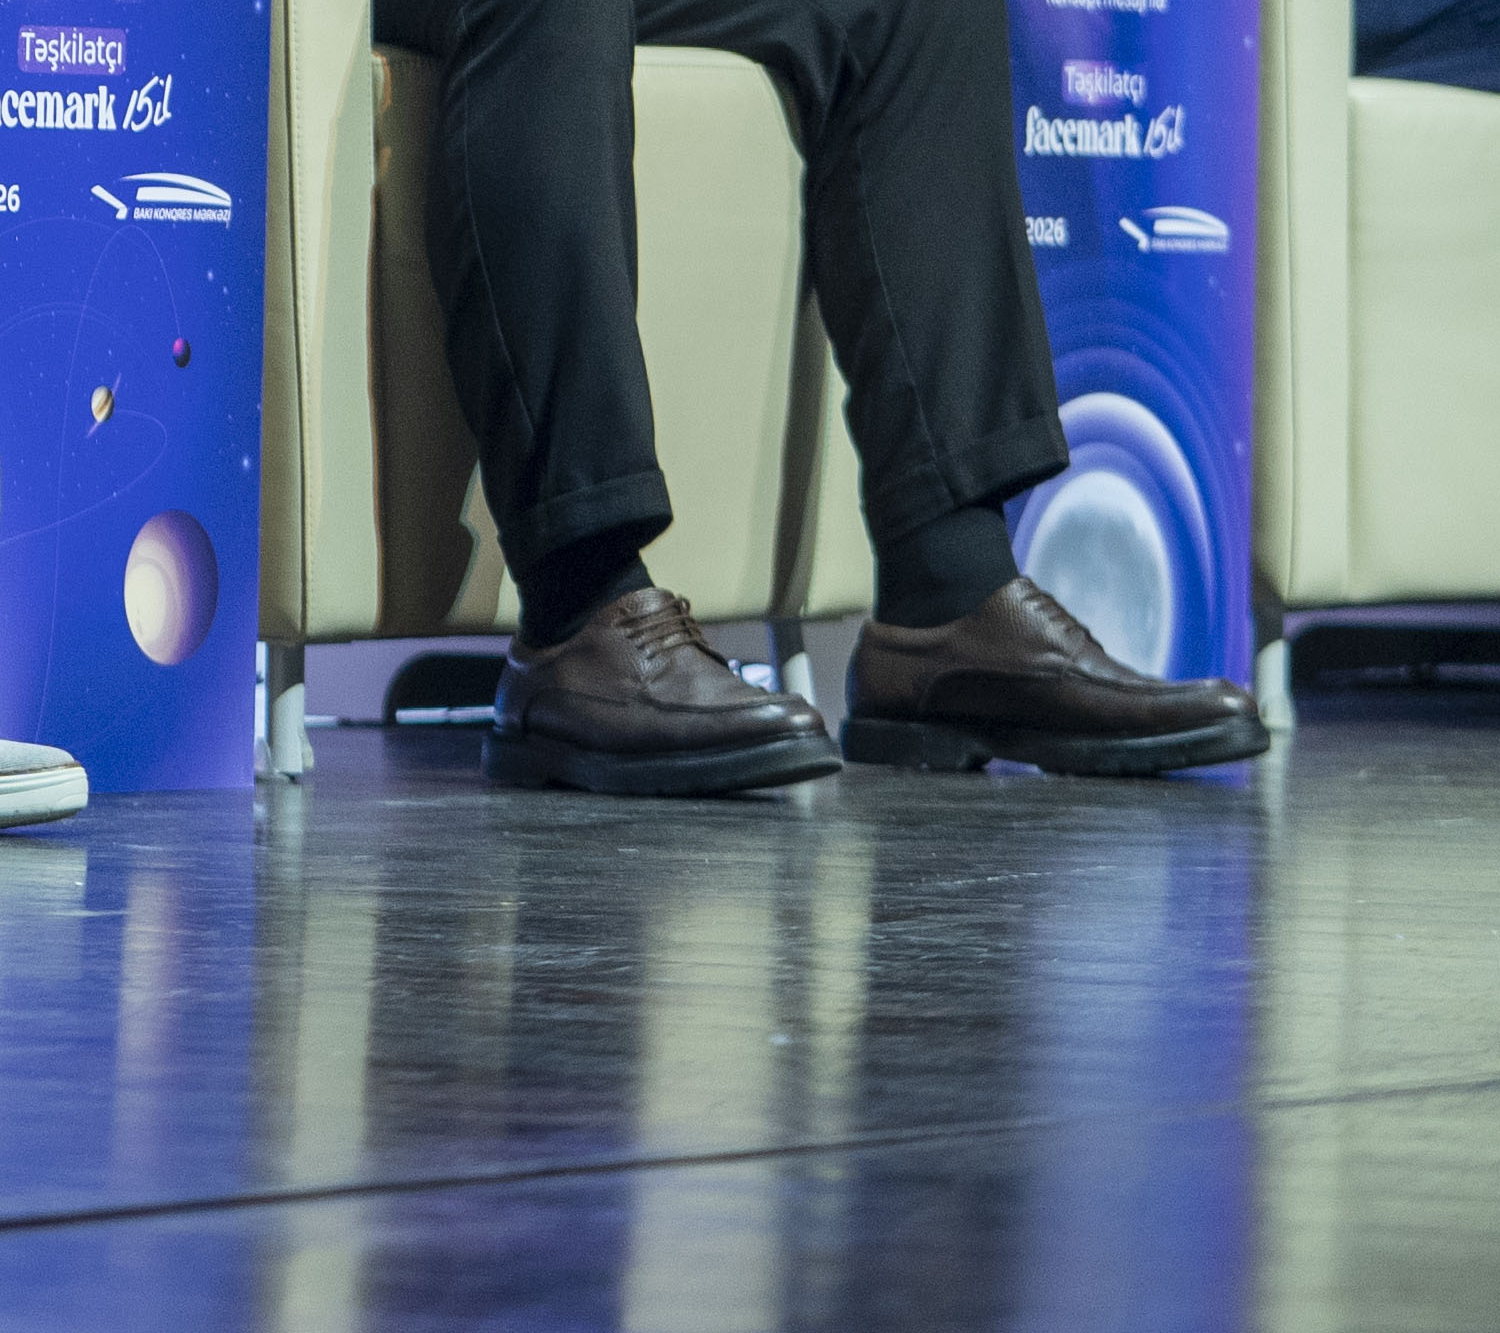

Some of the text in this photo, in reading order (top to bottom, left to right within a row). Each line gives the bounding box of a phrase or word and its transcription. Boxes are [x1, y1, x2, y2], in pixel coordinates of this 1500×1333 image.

[21, 31, 123, 74] Təşkilatçı
[1023, 105, 1142, 159] facemark
[1025, 215, 1068, 247] 2026
